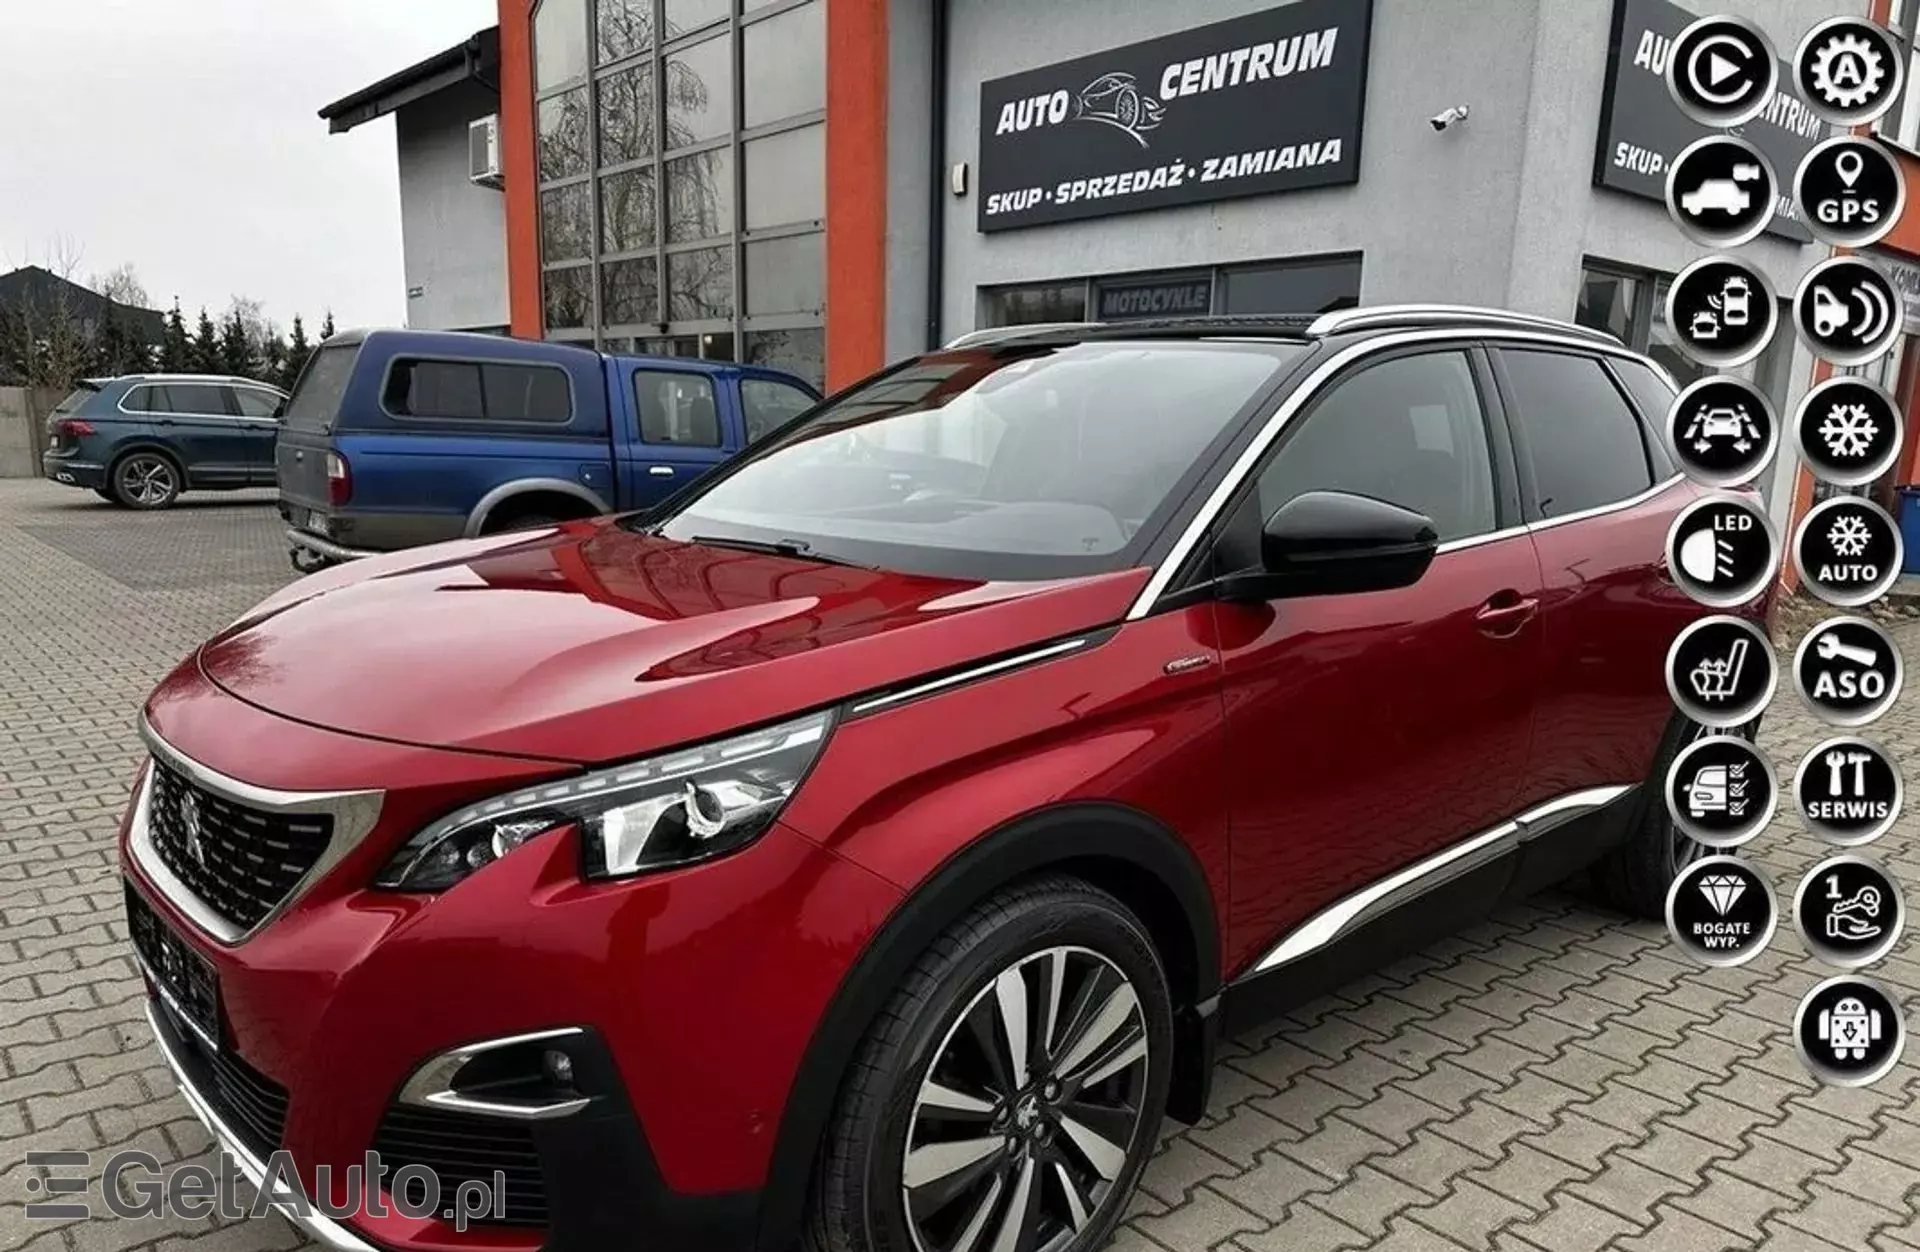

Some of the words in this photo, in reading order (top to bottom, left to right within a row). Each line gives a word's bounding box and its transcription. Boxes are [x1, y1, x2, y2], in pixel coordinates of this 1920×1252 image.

[996, 90, 1069, 136] AUTO
[1159, 27, 1339, 101] CENTRUM
[1633, 29, 1671, 76] AU
[1759, 91, 1821, 141] NTRUM
[986, 187, 1043, 215] SKUP
[1054, 158, 1186, 205] SPRZEDAŻ
[1200, 138, 1343, 183] ZAMIANA
[1613, 141, 1663, 176] SKUP
[1103, 285, 1207, 315] MOTOCYKLE
